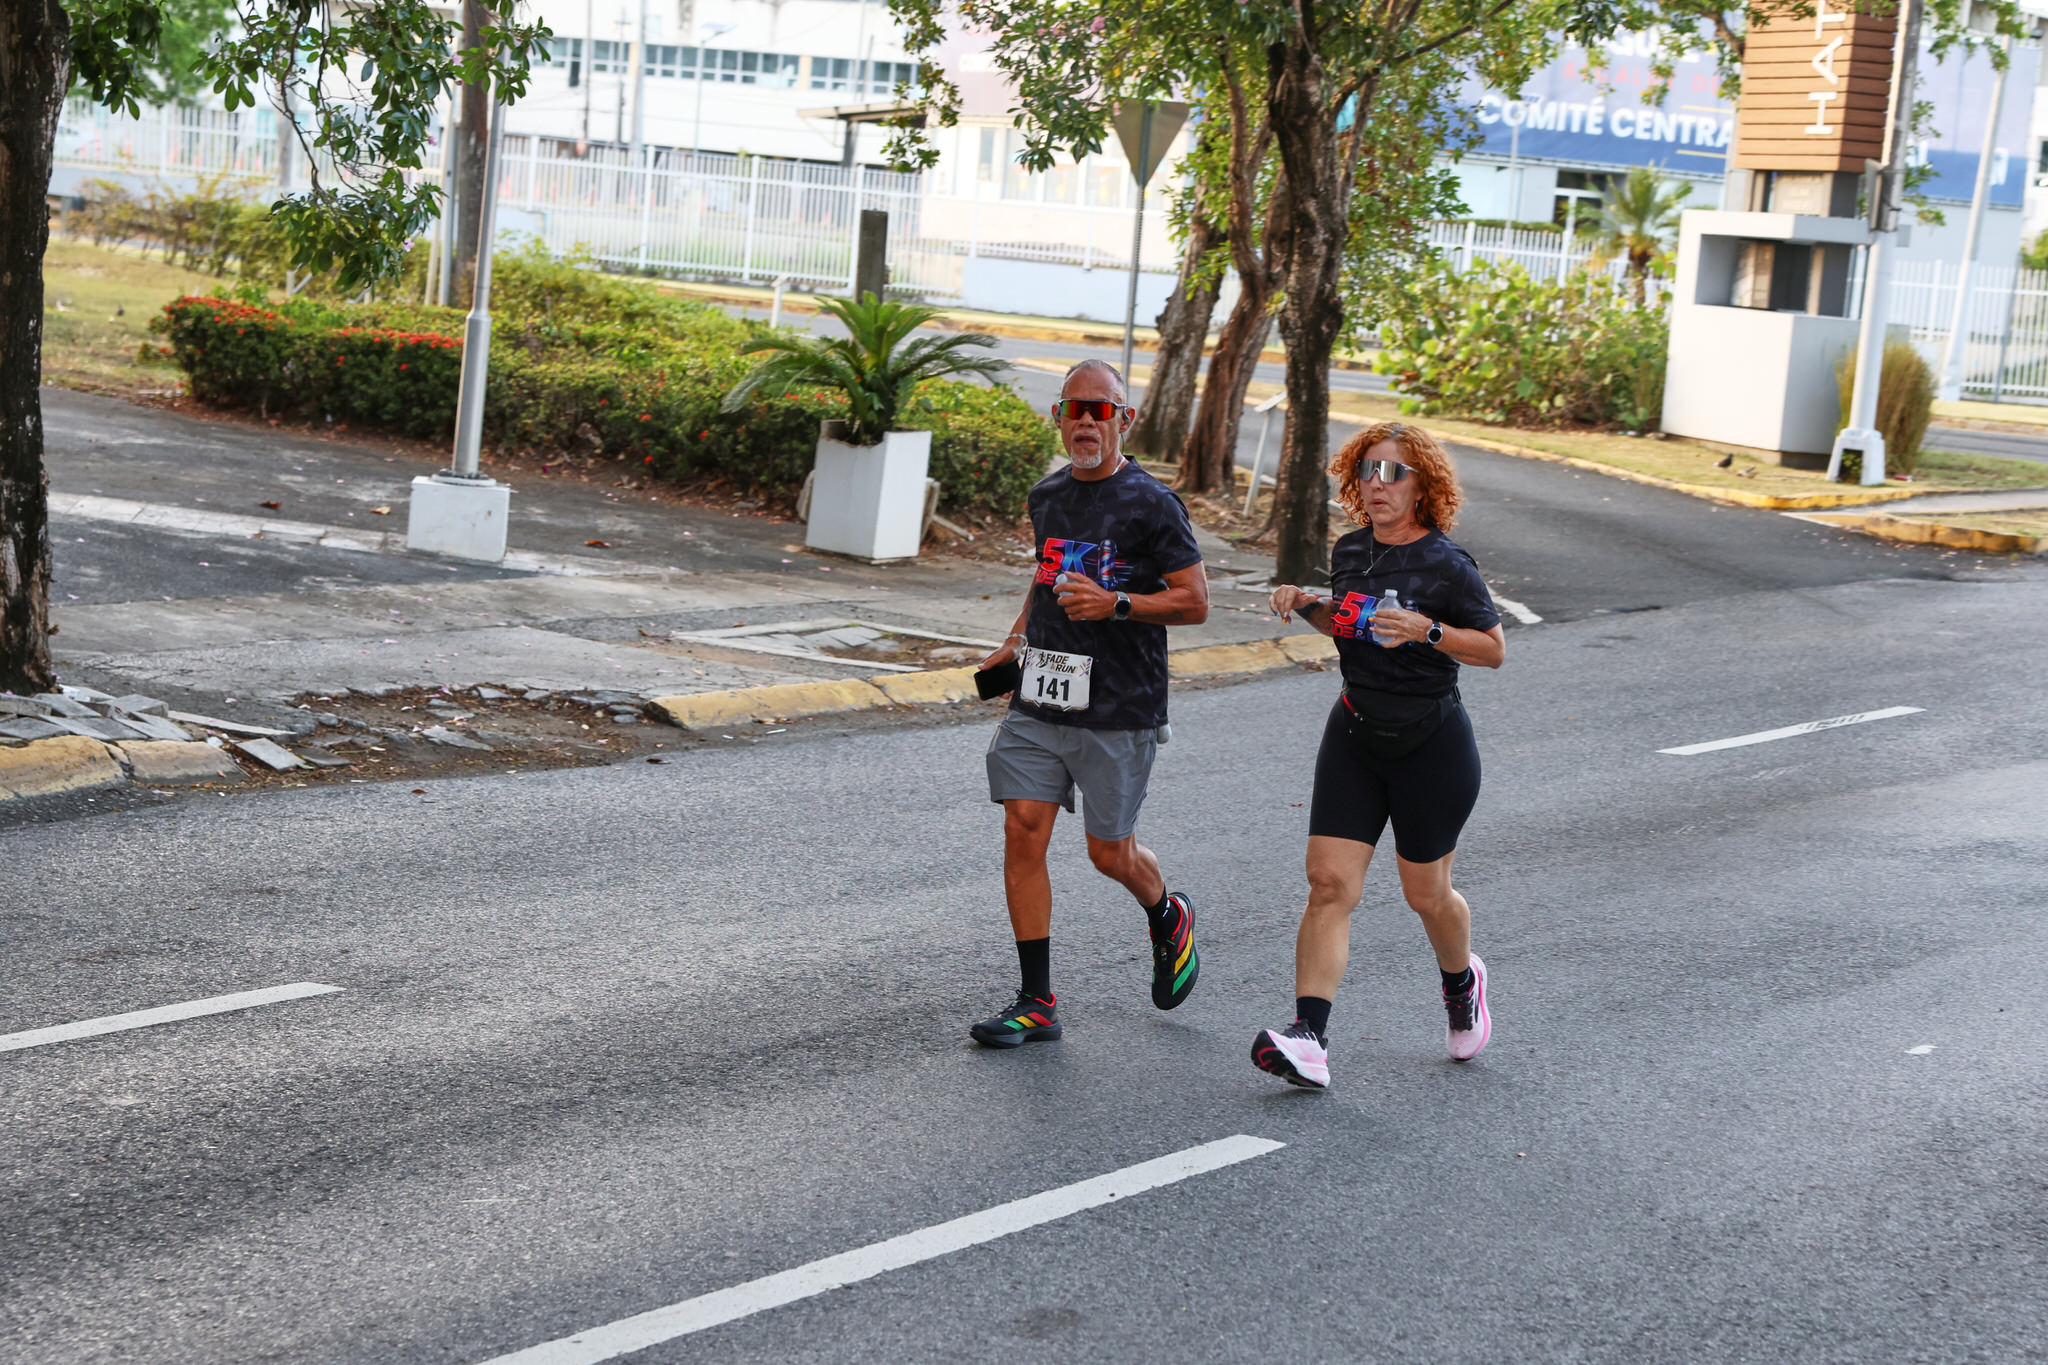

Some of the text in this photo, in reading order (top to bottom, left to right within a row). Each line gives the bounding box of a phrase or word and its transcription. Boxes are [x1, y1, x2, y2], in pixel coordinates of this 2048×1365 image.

[1477, 95, 1605, 136] COMITÉ
[1040, 537, 1098, 577] 5K
[1331, 623, 1354, 638] DE
[1046, 653, 1070, 664] FADE
[1055, 664, 1077, 674] RUN
[1036, 675, 1070, 702] 141
